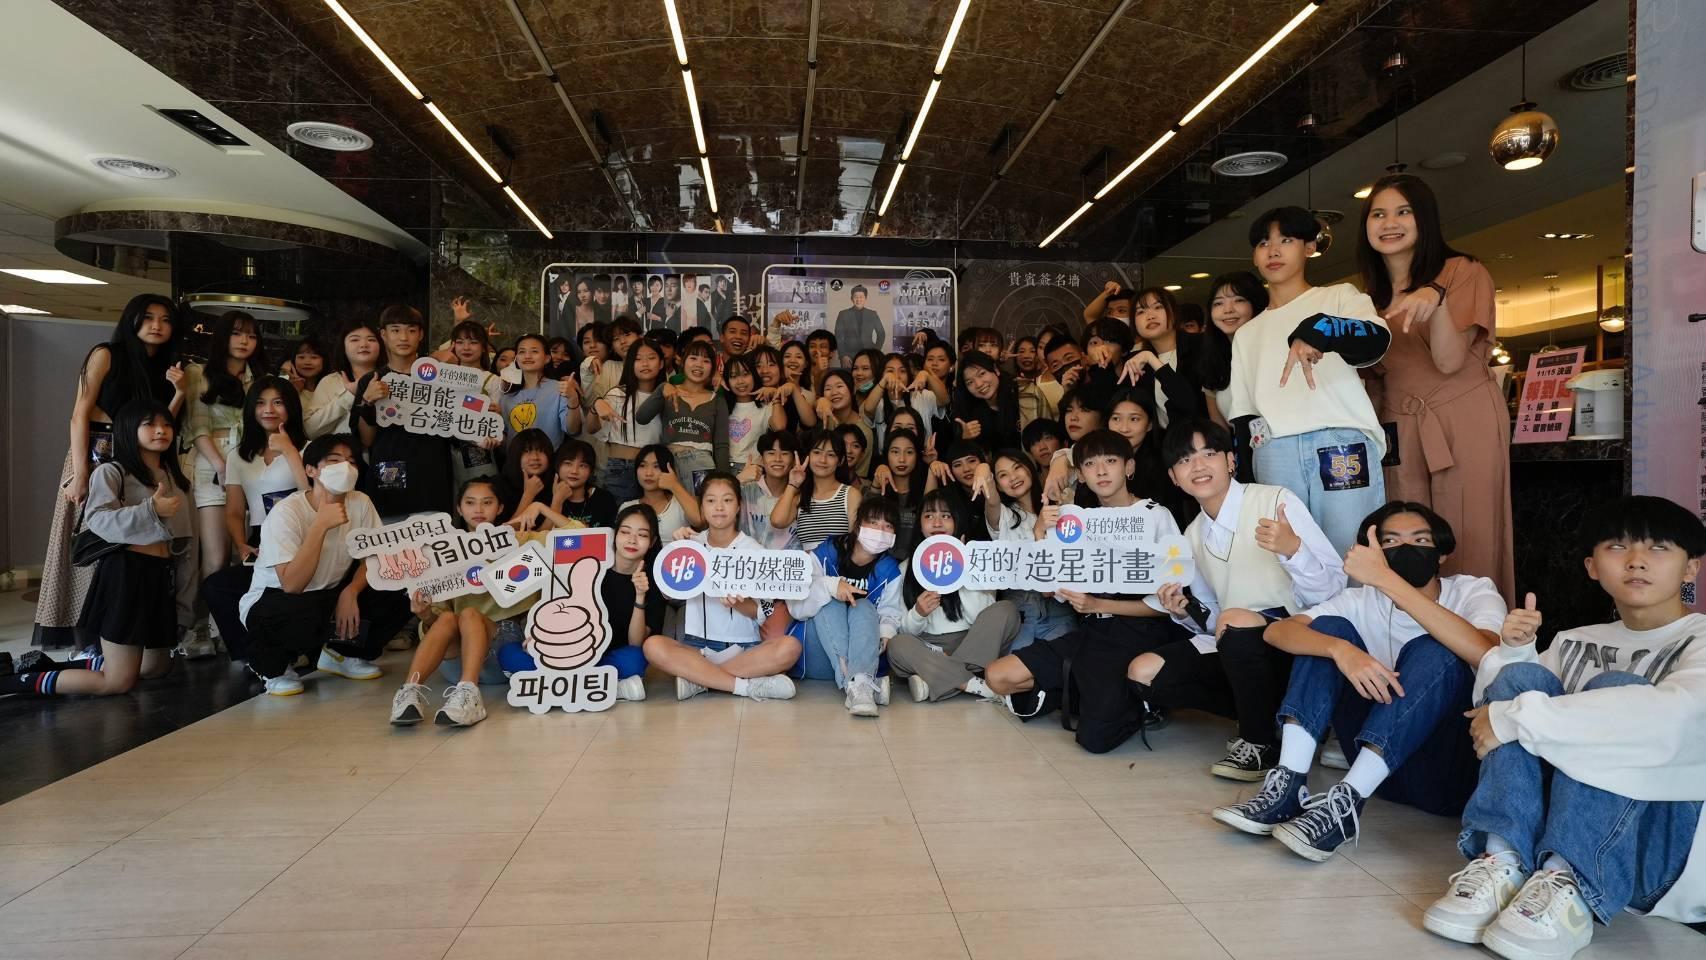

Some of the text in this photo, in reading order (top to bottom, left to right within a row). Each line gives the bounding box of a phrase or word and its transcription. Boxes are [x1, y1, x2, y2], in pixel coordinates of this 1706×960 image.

[439, 368, 479, 384] 好的媒體
[388, 378, 455, 410] 韓國能
[410, 406, 499, 439] 台灣也能
[1332, 454, 1361, 477] 55
[354, 519, 449, 550] Fighting
[1086, 516, 1144, 535] 好的媒體
[431, 529, 513, 567] 파이팅
[710, 554, 805, 582] 好的媒體
[972, 573, 1006, 583] Nice
[1024, 547, 1155, 584] 造星計畫
[711, 580, 802, 593] Nice Media
[516, 672, 609, 705] 파이팅
